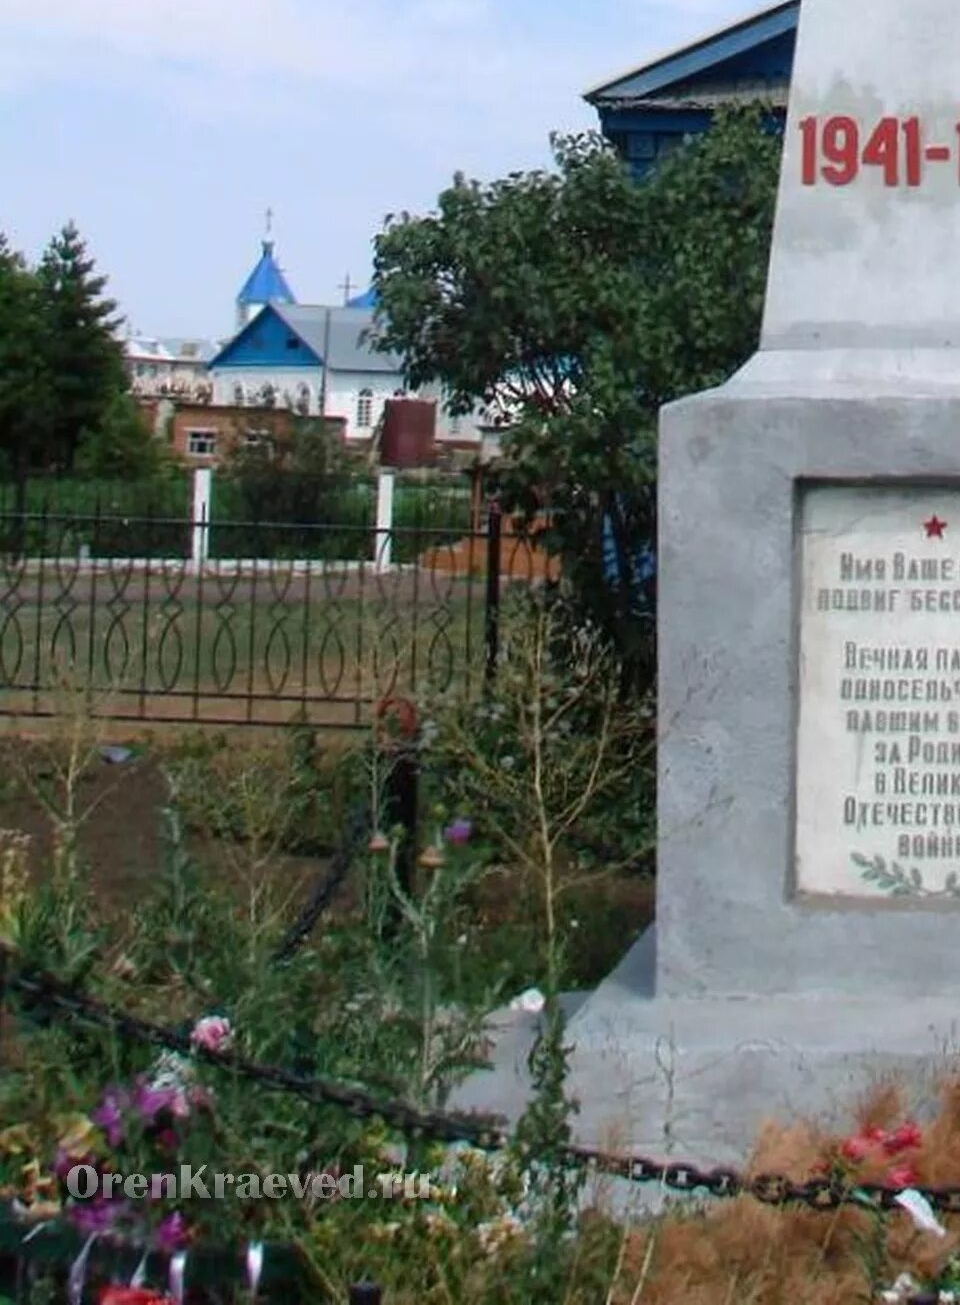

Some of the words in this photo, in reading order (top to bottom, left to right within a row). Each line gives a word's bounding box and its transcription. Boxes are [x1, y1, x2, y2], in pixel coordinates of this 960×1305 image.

[893, 553, 955, 581] ВАШЕ
[817, 589, 899, 612] ПОДВИГ
[845, 642, 928, 670] ВЕЧНАЯ
[846, 710, 939, 733] ПАВШИМ
[947, 711, 959, 733] В
[875, 742, 901, 764] ЗА
[875, 772, 886, 794] В
